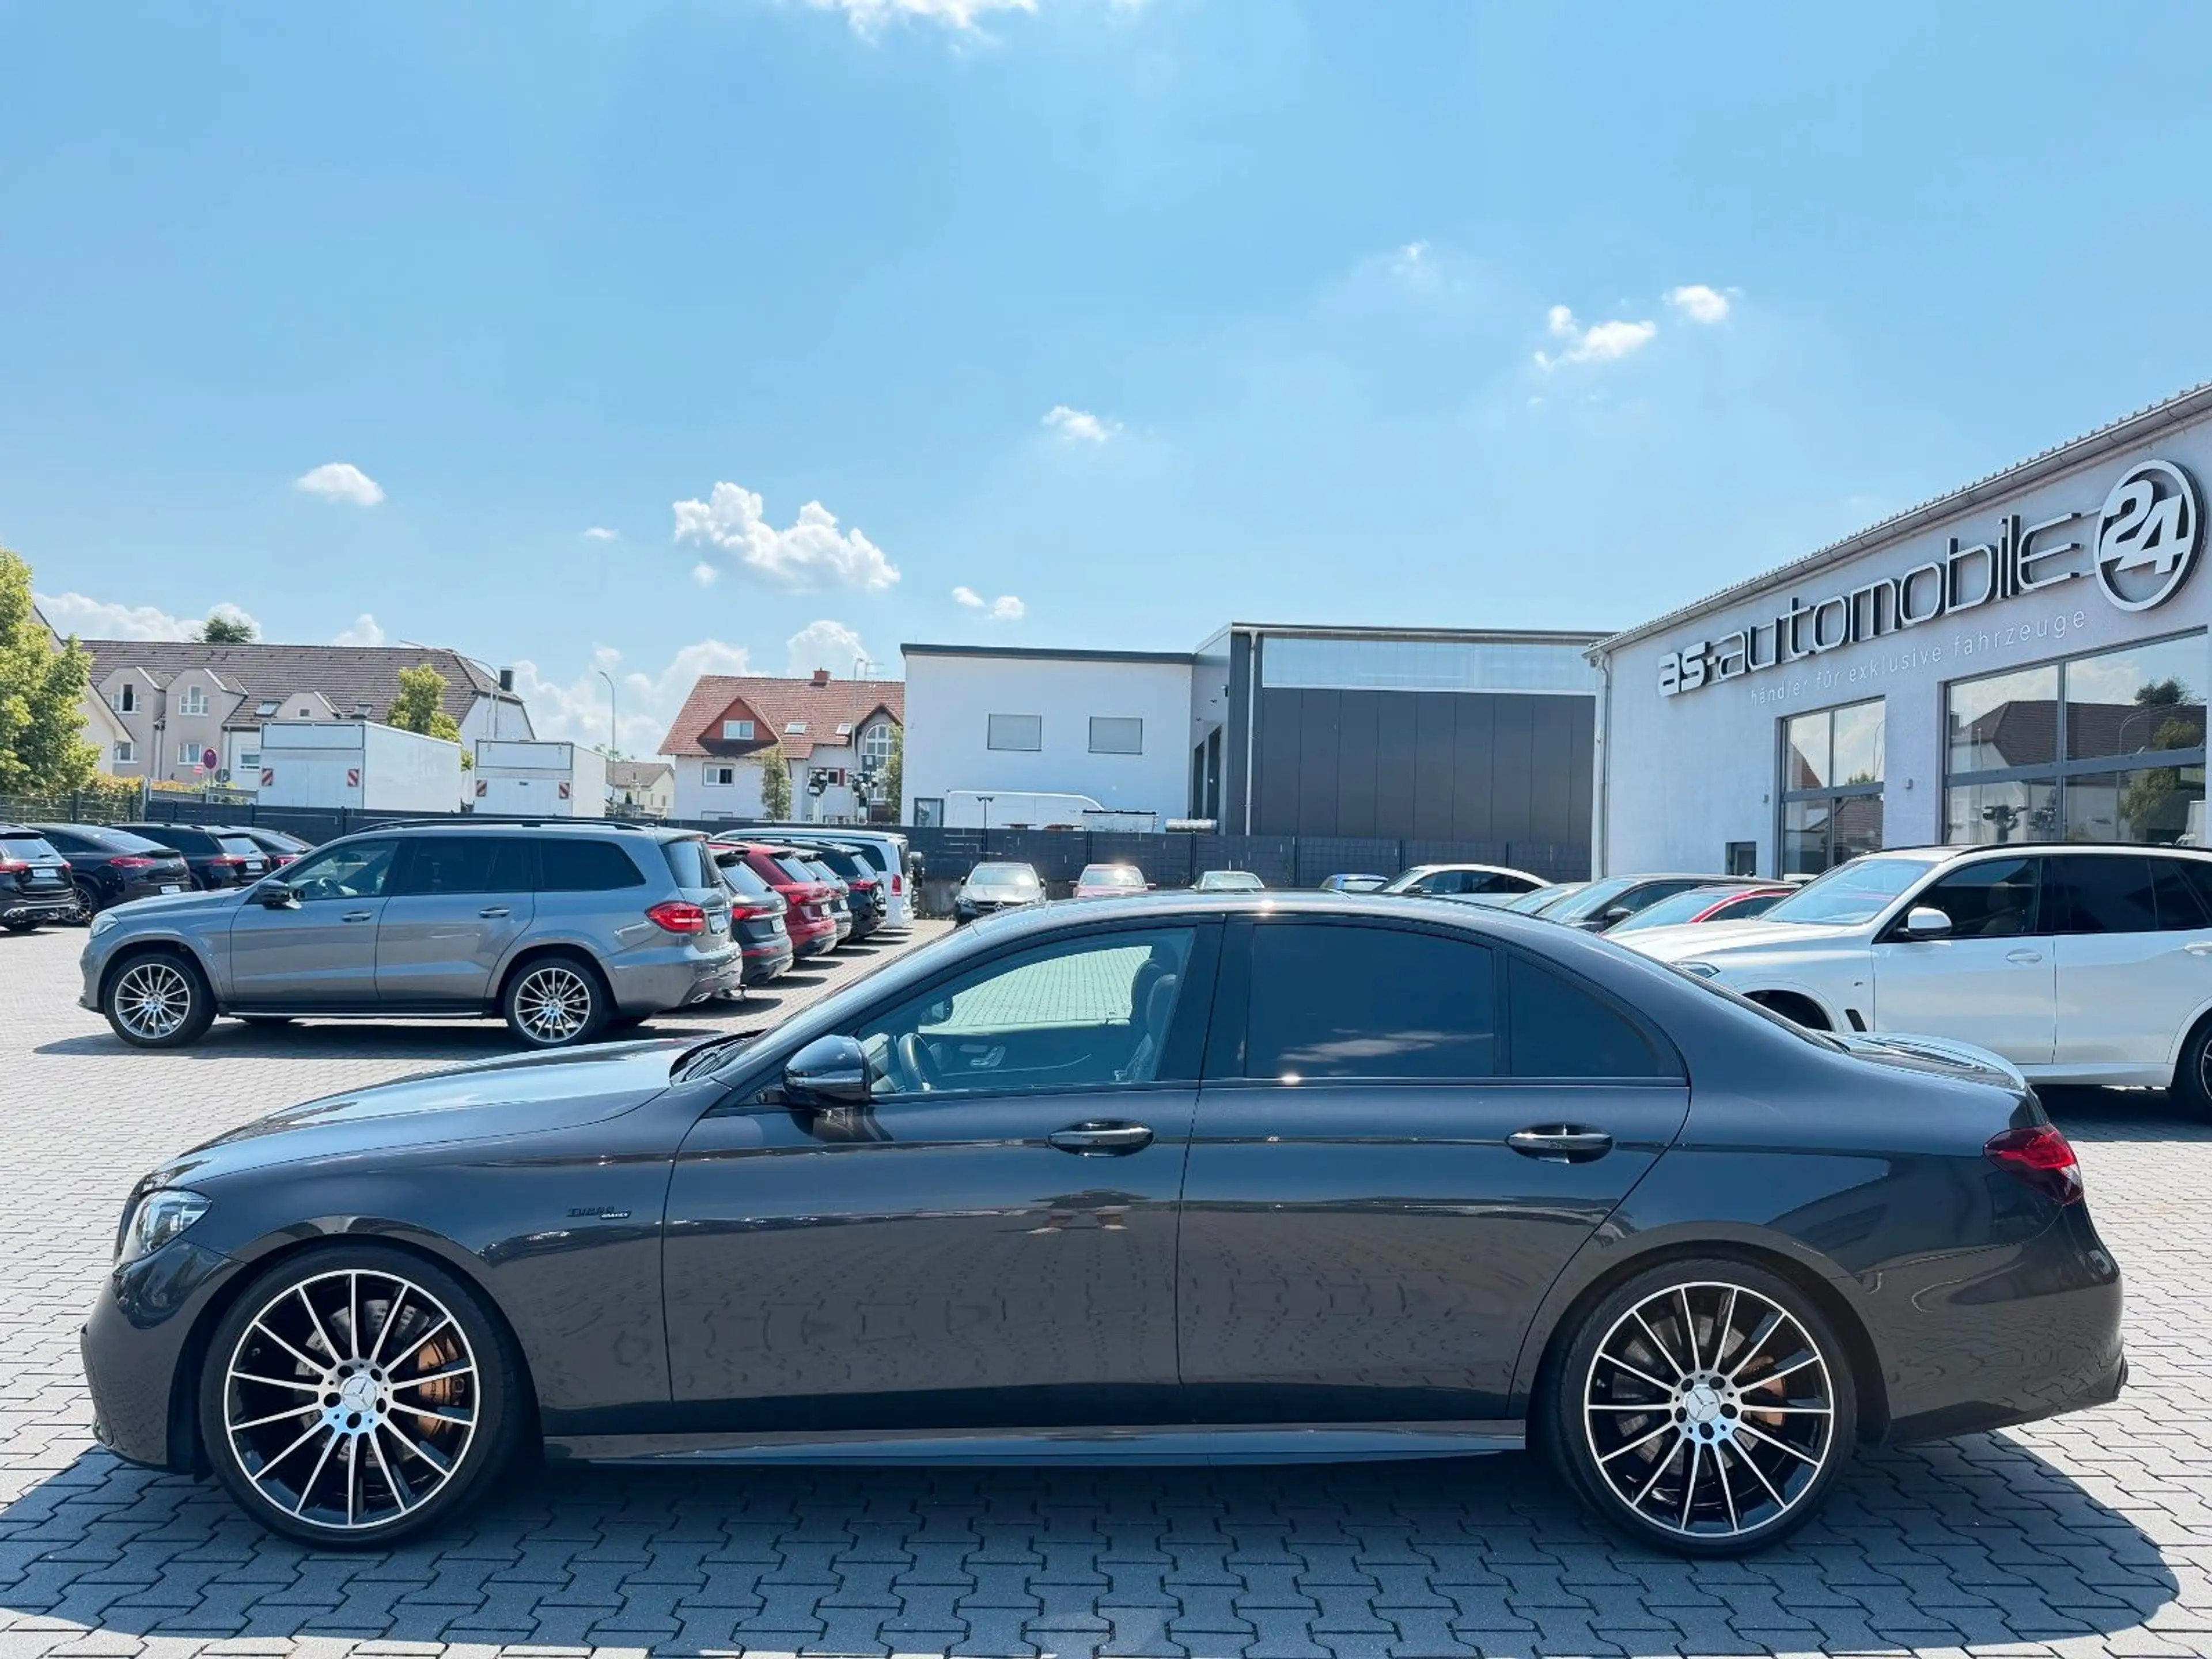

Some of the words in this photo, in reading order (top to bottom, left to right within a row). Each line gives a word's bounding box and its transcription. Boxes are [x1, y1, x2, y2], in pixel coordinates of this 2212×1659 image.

[2099, 479, 2189, 575] 24
[1751, 679, 1808, 707] händler
[1816, 668, 1843, 691] für
[1849, 645, 1942, 684] exklusive
[1953, 609, 2086, 660] fahrzeuge
